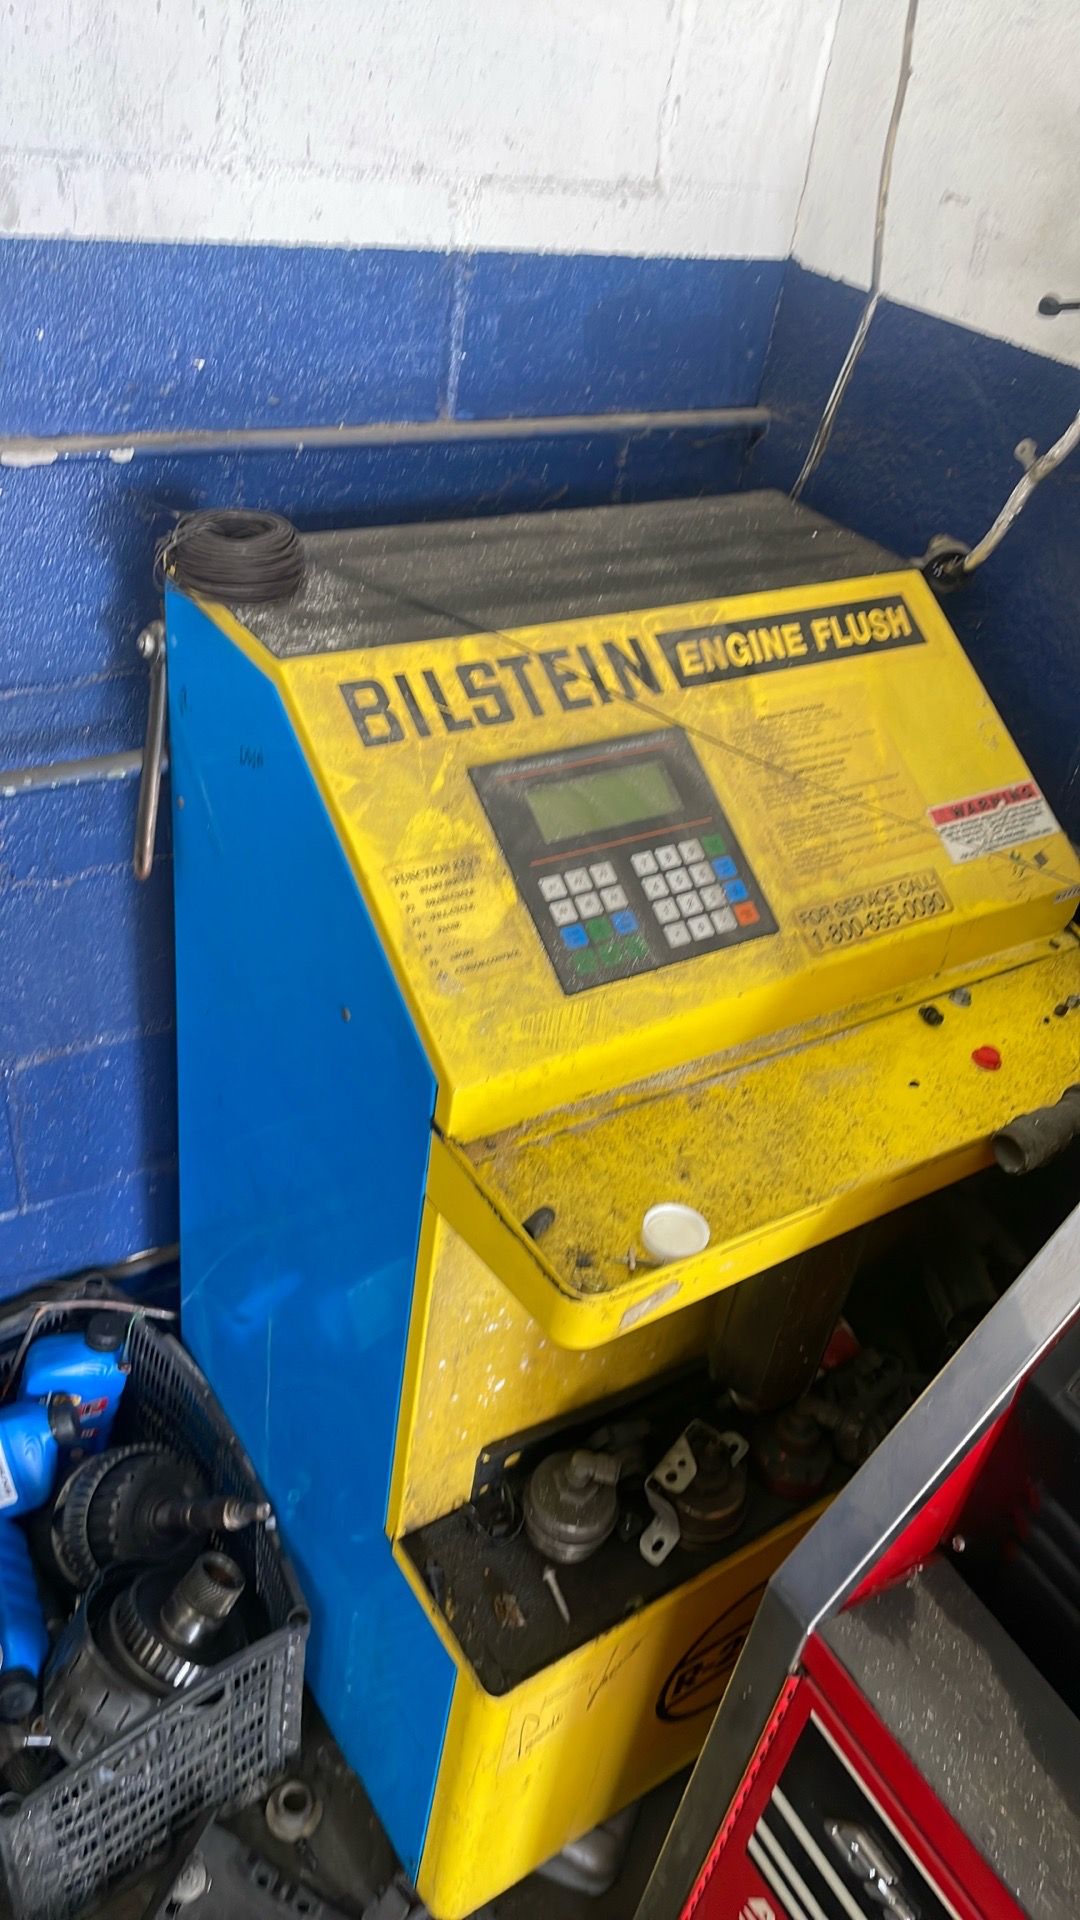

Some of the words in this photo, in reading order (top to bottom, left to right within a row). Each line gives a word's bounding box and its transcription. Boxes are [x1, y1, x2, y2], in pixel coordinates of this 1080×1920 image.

[339, 636, 663, 747] BILSTEIN
[676, 624, 808, 678] ENGINE
[814, 604, 912, 653] FLUSH
[800, 904, 830, 926] FOR
[834, 884, 898, 917] SERVICE
[898, 874, 938, 898] CALL
